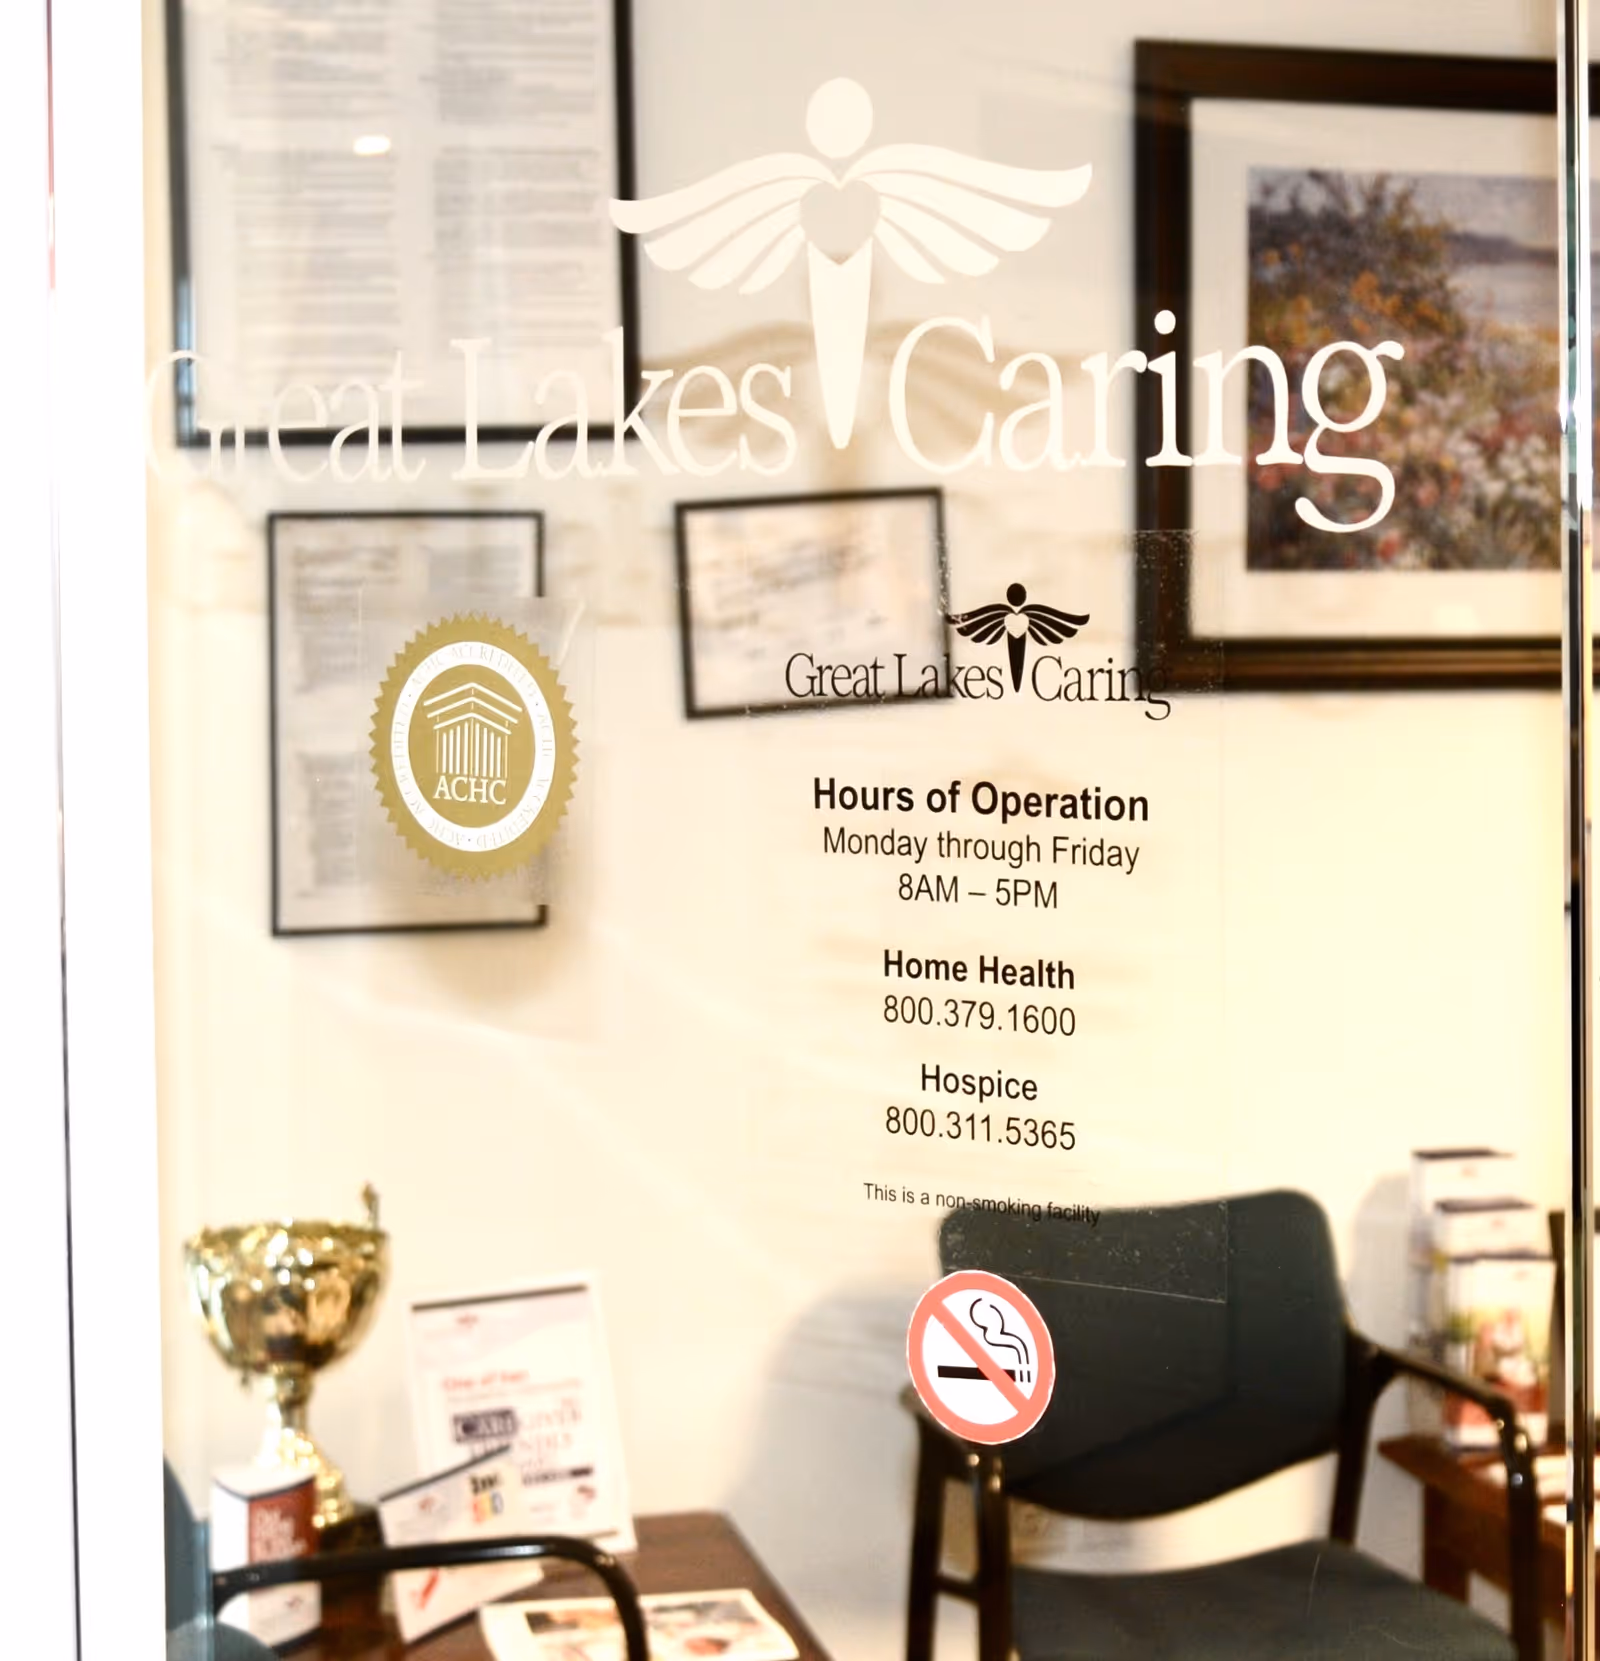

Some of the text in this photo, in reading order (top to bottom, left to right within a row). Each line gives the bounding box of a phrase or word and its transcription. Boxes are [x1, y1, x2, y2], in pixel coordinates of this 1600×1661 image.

[450, 327, 797, 479] Lakes
[889, 310, 1405, 533] Caring
[785, 652, 1172, 721] Great Lakes Caring
[433, 775, 507, 805] ACHC
[813, 777, 1149, 824] Hours of Operation
[823, 826, 1140, 875] Monday through Friday
[898, 873, 959, 903] 8AM
[995, 878, 1058, 909] 5PM
[884, 949, 1075, 990] Home Health
[883, 994, 1076, 1036] 800.379.1600
[921, 1063, 1038, 1103] Hospice
[885, 1106, 1076, 1150] 800.311.5365
[863, 1182, 1101, 1228] This is a non-smoking facility
